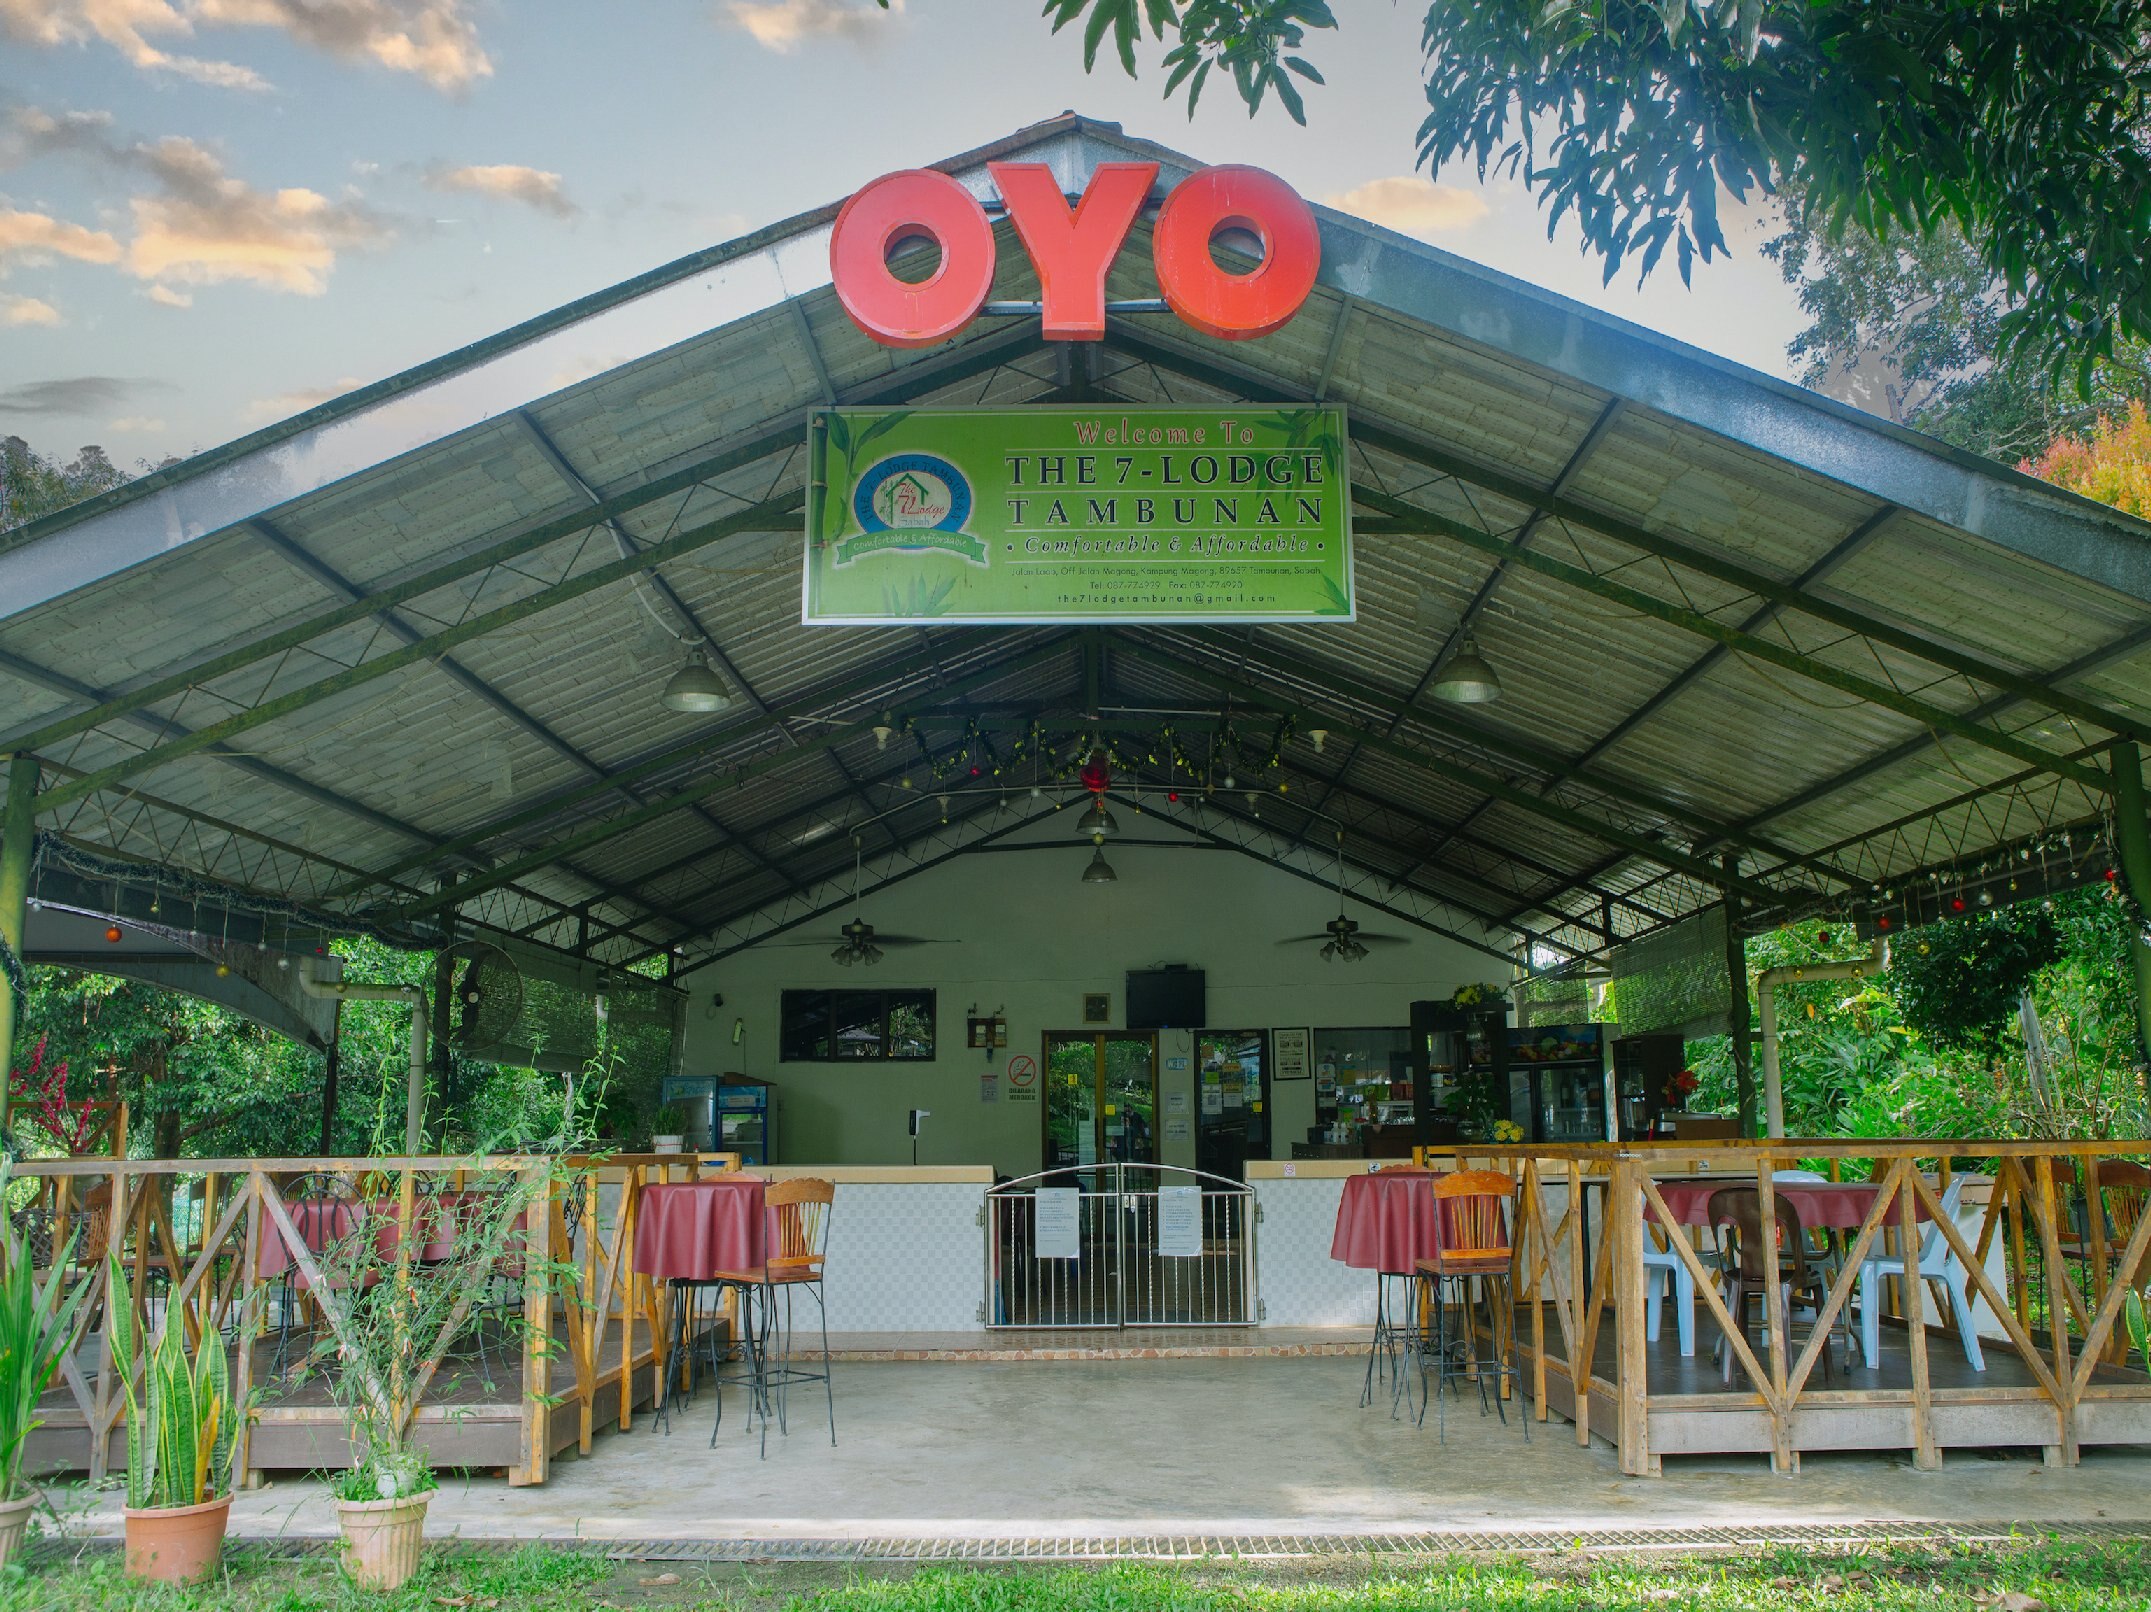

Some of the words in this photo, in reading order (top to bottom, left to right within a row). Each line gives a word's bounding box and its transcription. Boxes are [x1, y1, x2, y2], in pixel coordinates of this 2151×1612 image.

[830, 162, 1321, 348] OYO
[1074, 417, 1206, 445] Welcome
[1221, 420, 1254, 444] To
[1005, 456, 1097, 486] THE
[1115, 455, 1324, 485] 7-LODGE
[898, 482, 915, 495] The
[1007, 498, 1322, 525] TAMBUNAN
[1025, 535, 1160, 557] Comfortable
[1169, 536, 1182, 551] &
[1191, 534, 1308, 556] Affordable
[1061, 567, 1076, 576] Off
[1141, 567, 1178, 577] Kampung
